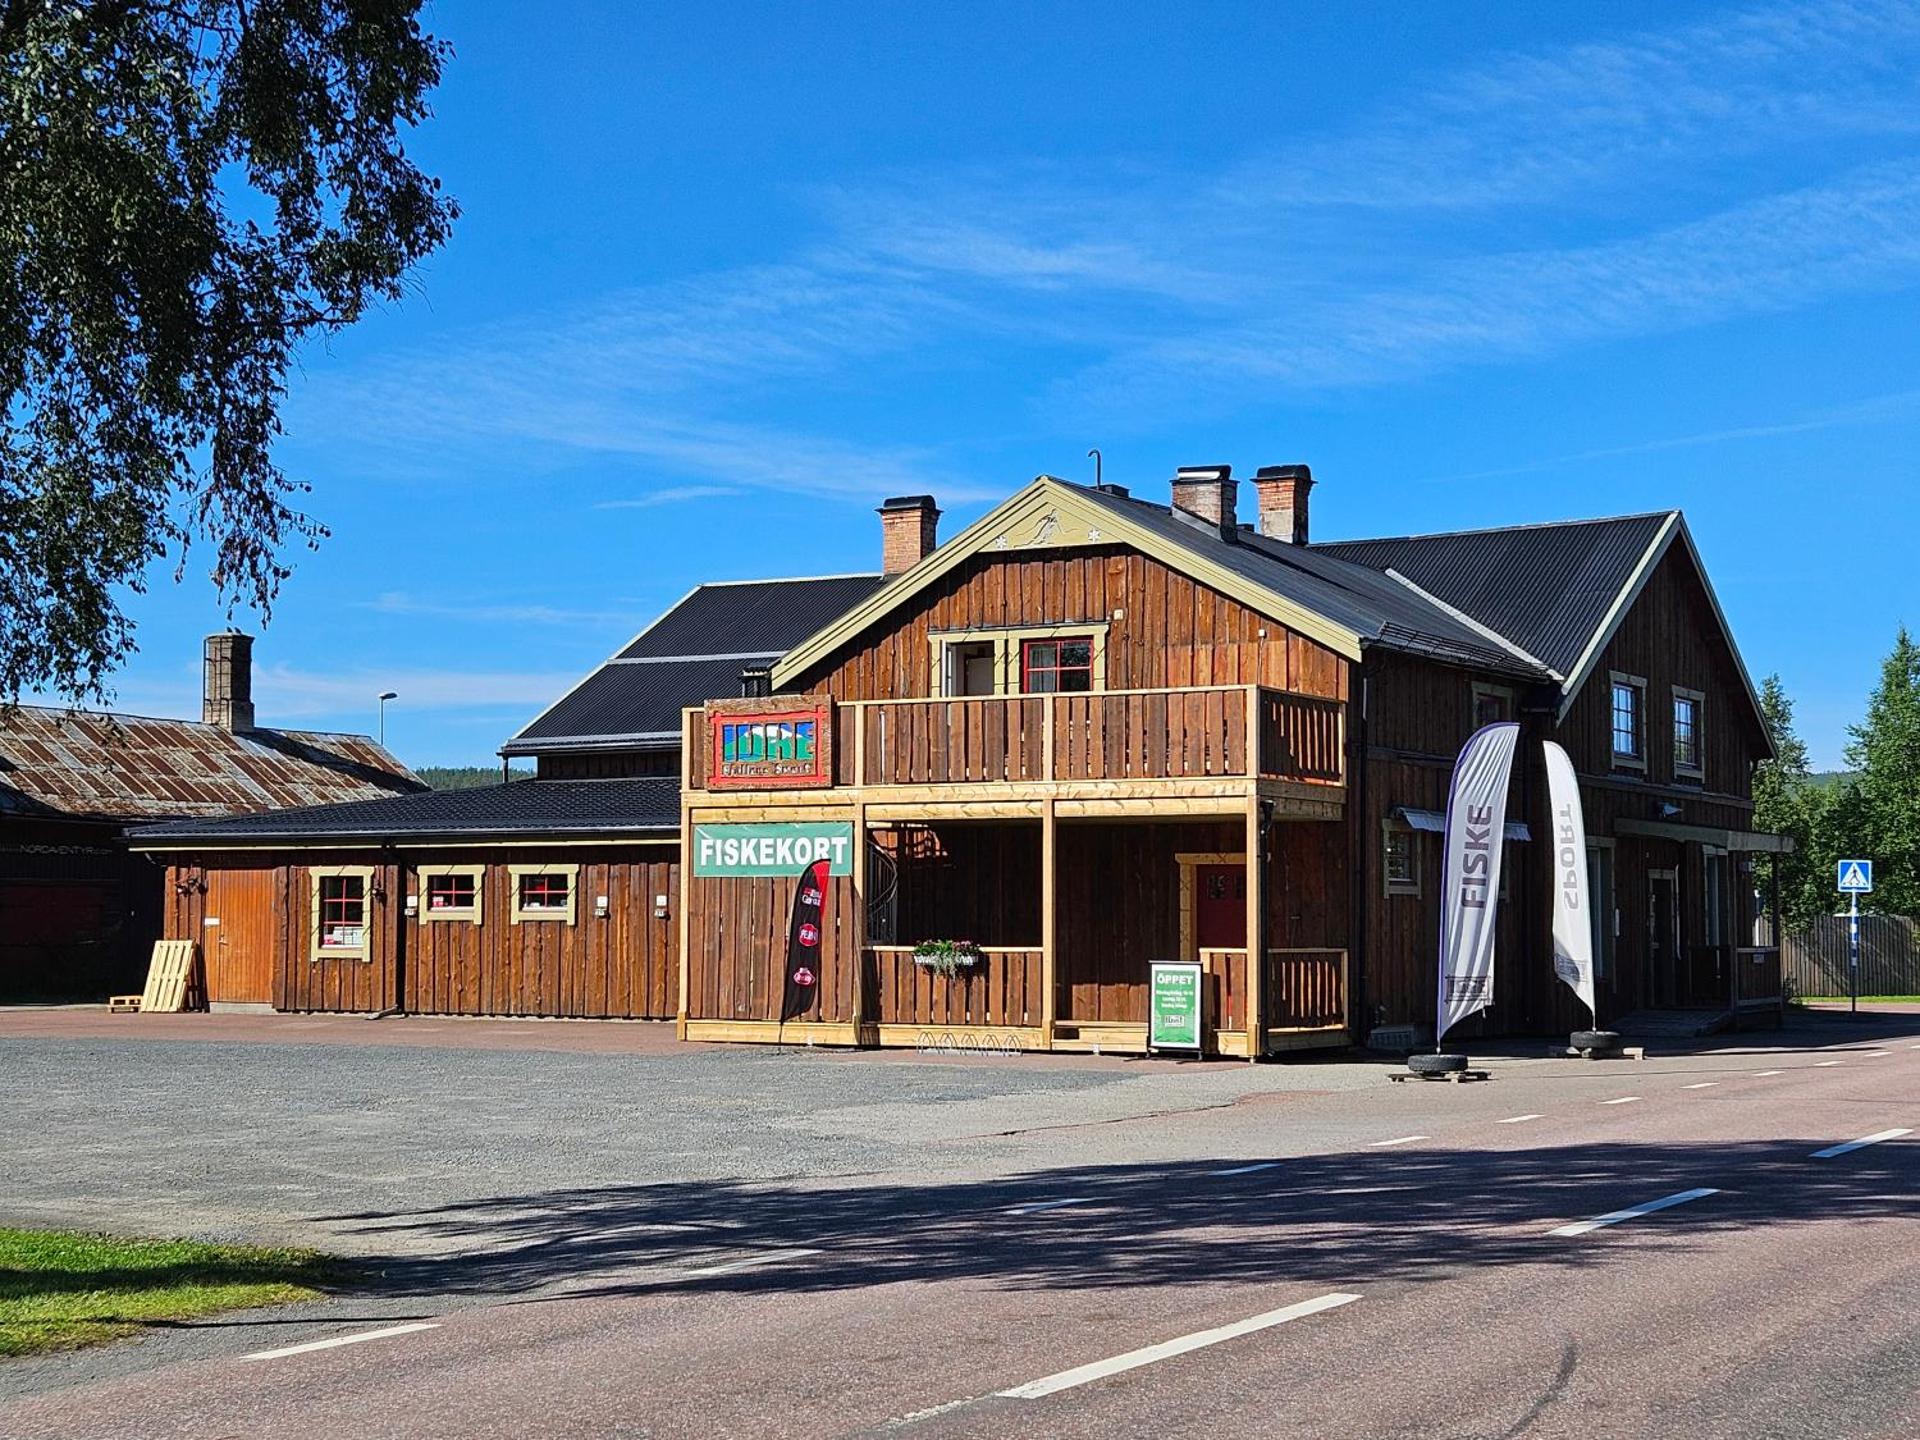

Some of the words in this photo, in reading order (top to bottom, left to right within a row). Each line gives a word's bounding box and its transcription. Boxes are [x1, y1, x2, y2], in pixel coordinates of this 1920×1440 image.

[722, 721, 814, 761] IDRE
[700, 836, 848, 866] FISKEKORT
[1461, 804, 1493, 909] FISKE
[1157, 973, 1193, 984] ÖPPET
